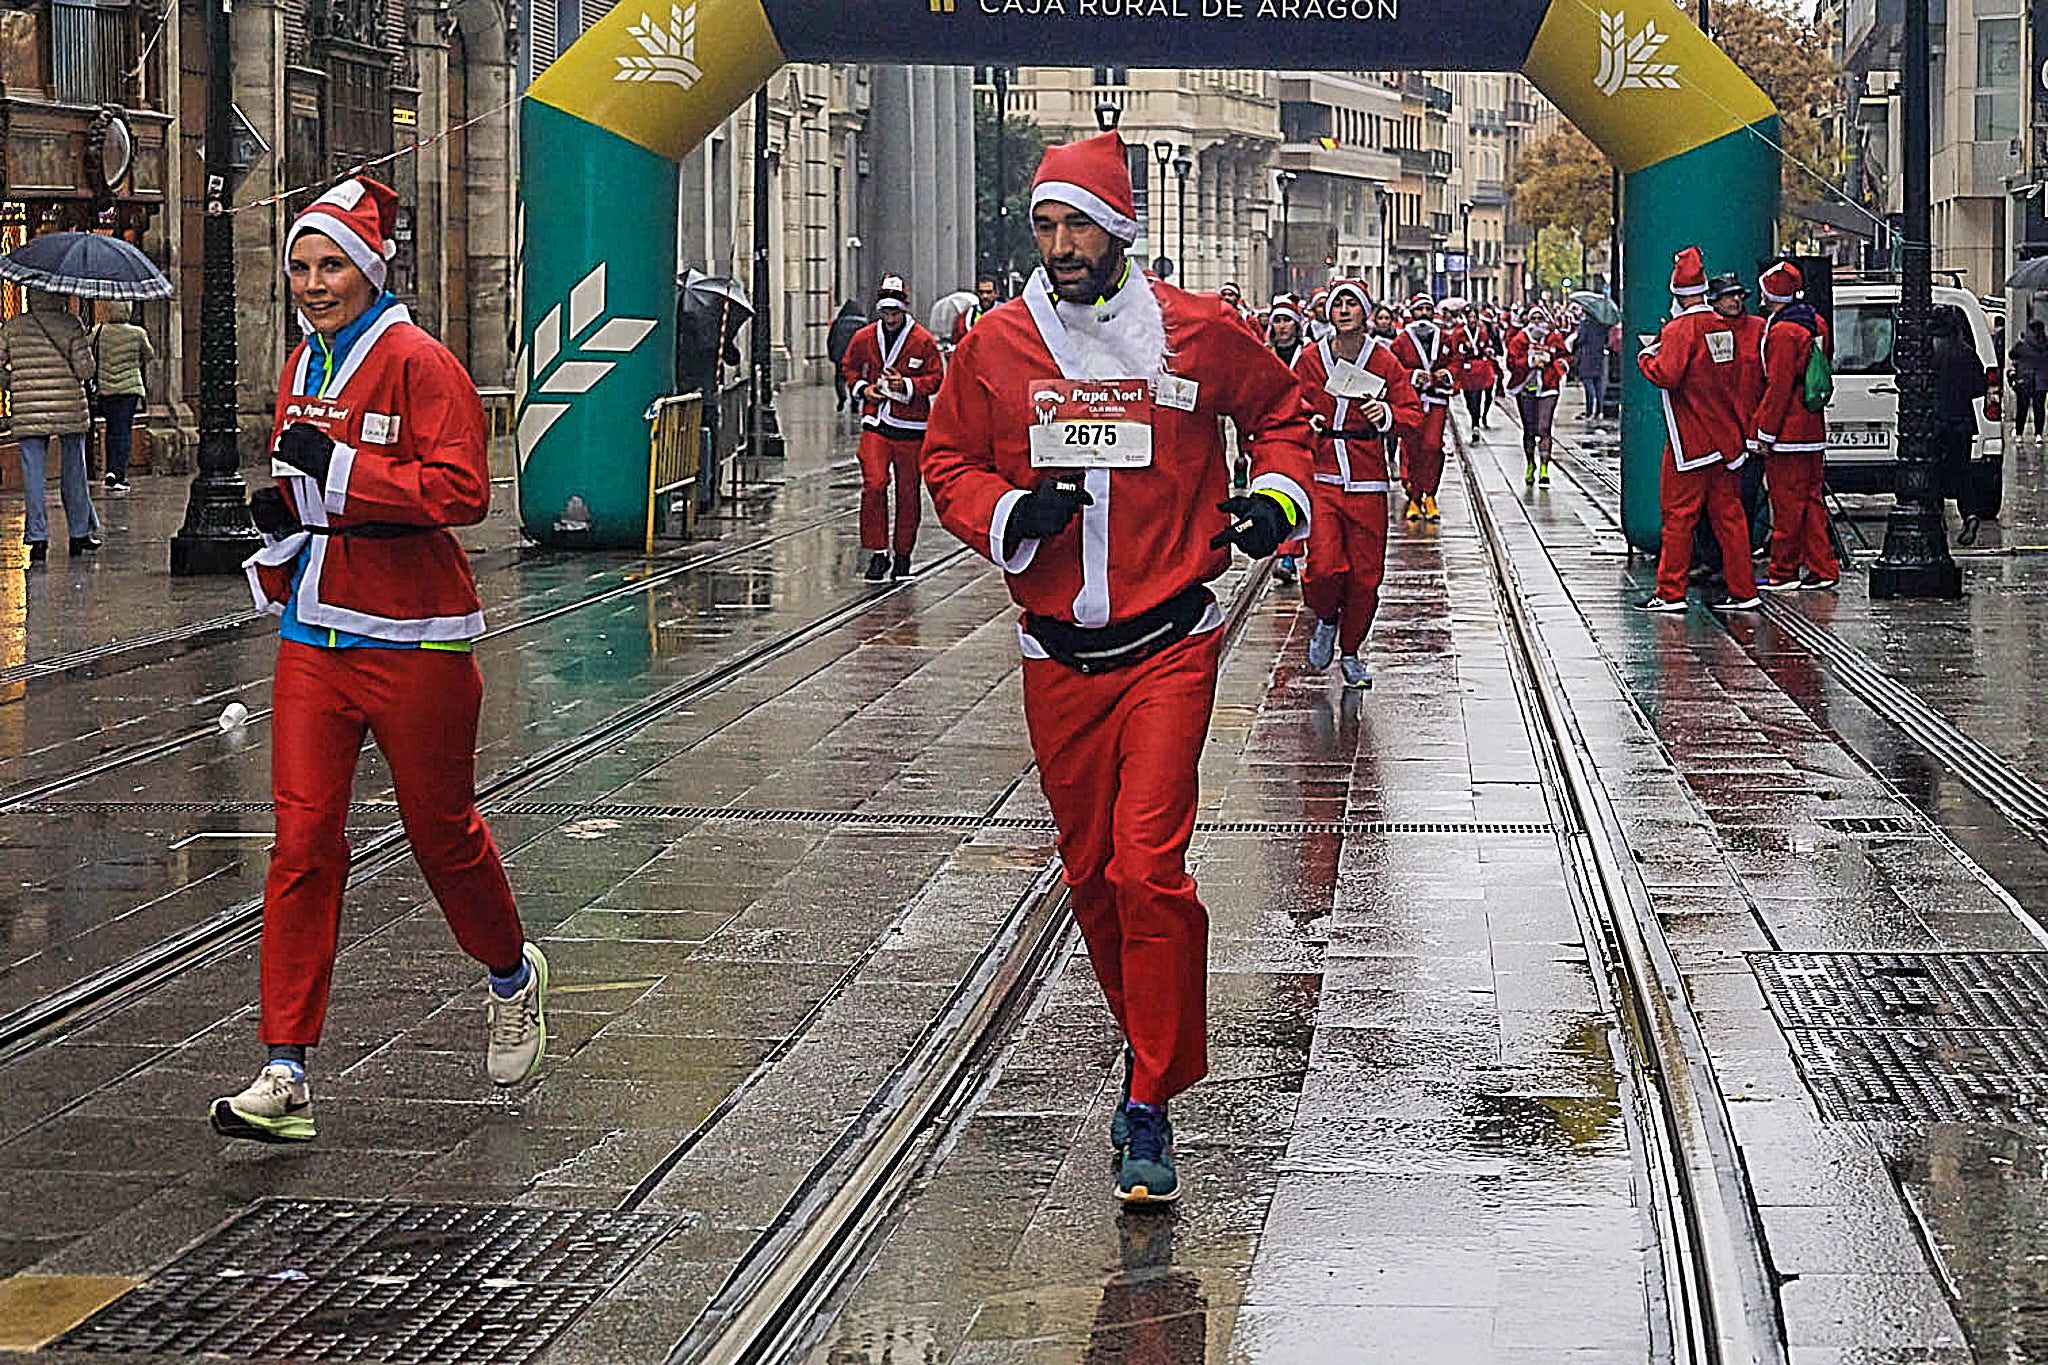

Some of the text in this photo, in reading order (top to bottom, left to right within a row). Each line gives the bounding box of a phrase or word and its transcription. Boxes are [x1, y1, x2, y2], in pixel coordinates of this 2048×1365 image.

[979, 0, 1066, 15] CAJA
[1079, 0, 1189, 17] RURAL
[1202, 0, 1244, 18] DE
[1072, 388, 1109, 405] Papá
[1064, 424, 1117, 446] 2675
